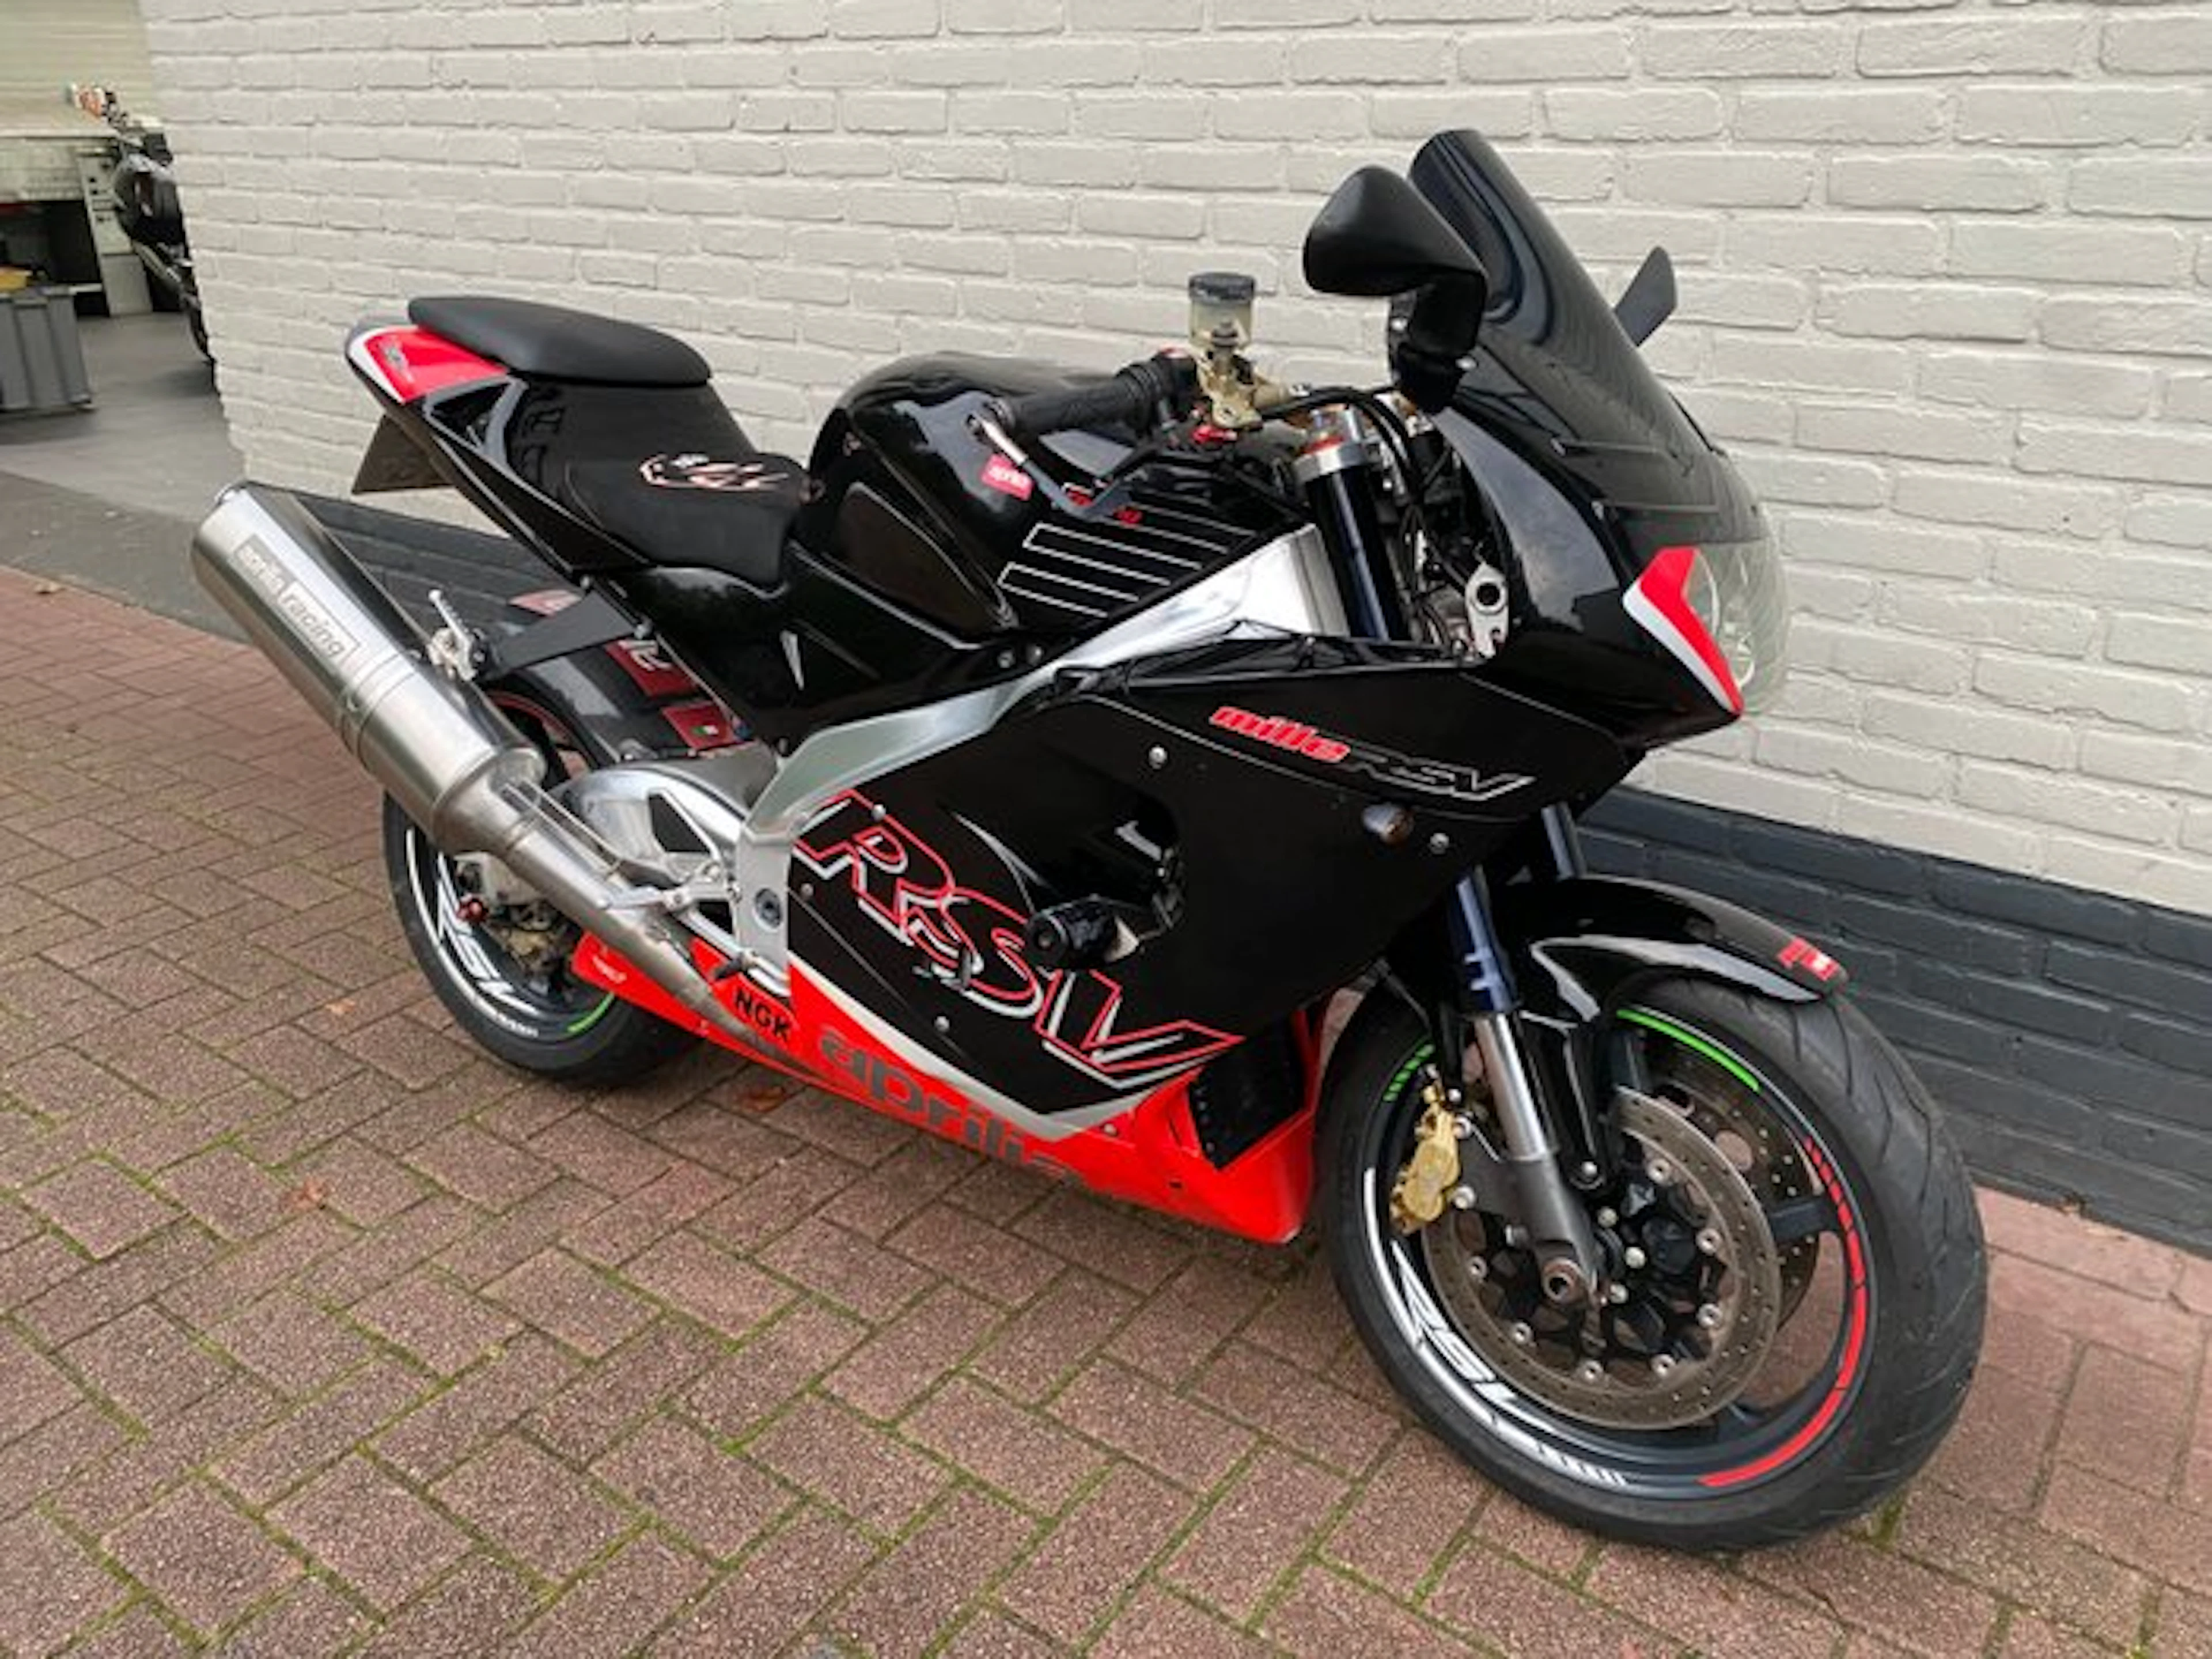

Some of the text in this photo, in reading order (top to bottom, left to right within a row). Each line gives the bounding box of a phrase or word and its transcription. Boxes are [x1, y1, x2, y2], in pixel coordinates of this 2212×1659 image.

[279, 590, 349, 661] racing
[1210, 705, 1537, 801] mille RSV
[789, 788, 1246, 1090] RSV
[736, 986, 793, 1043] NGK
[820, 1027, 1086, 1181] aprili
